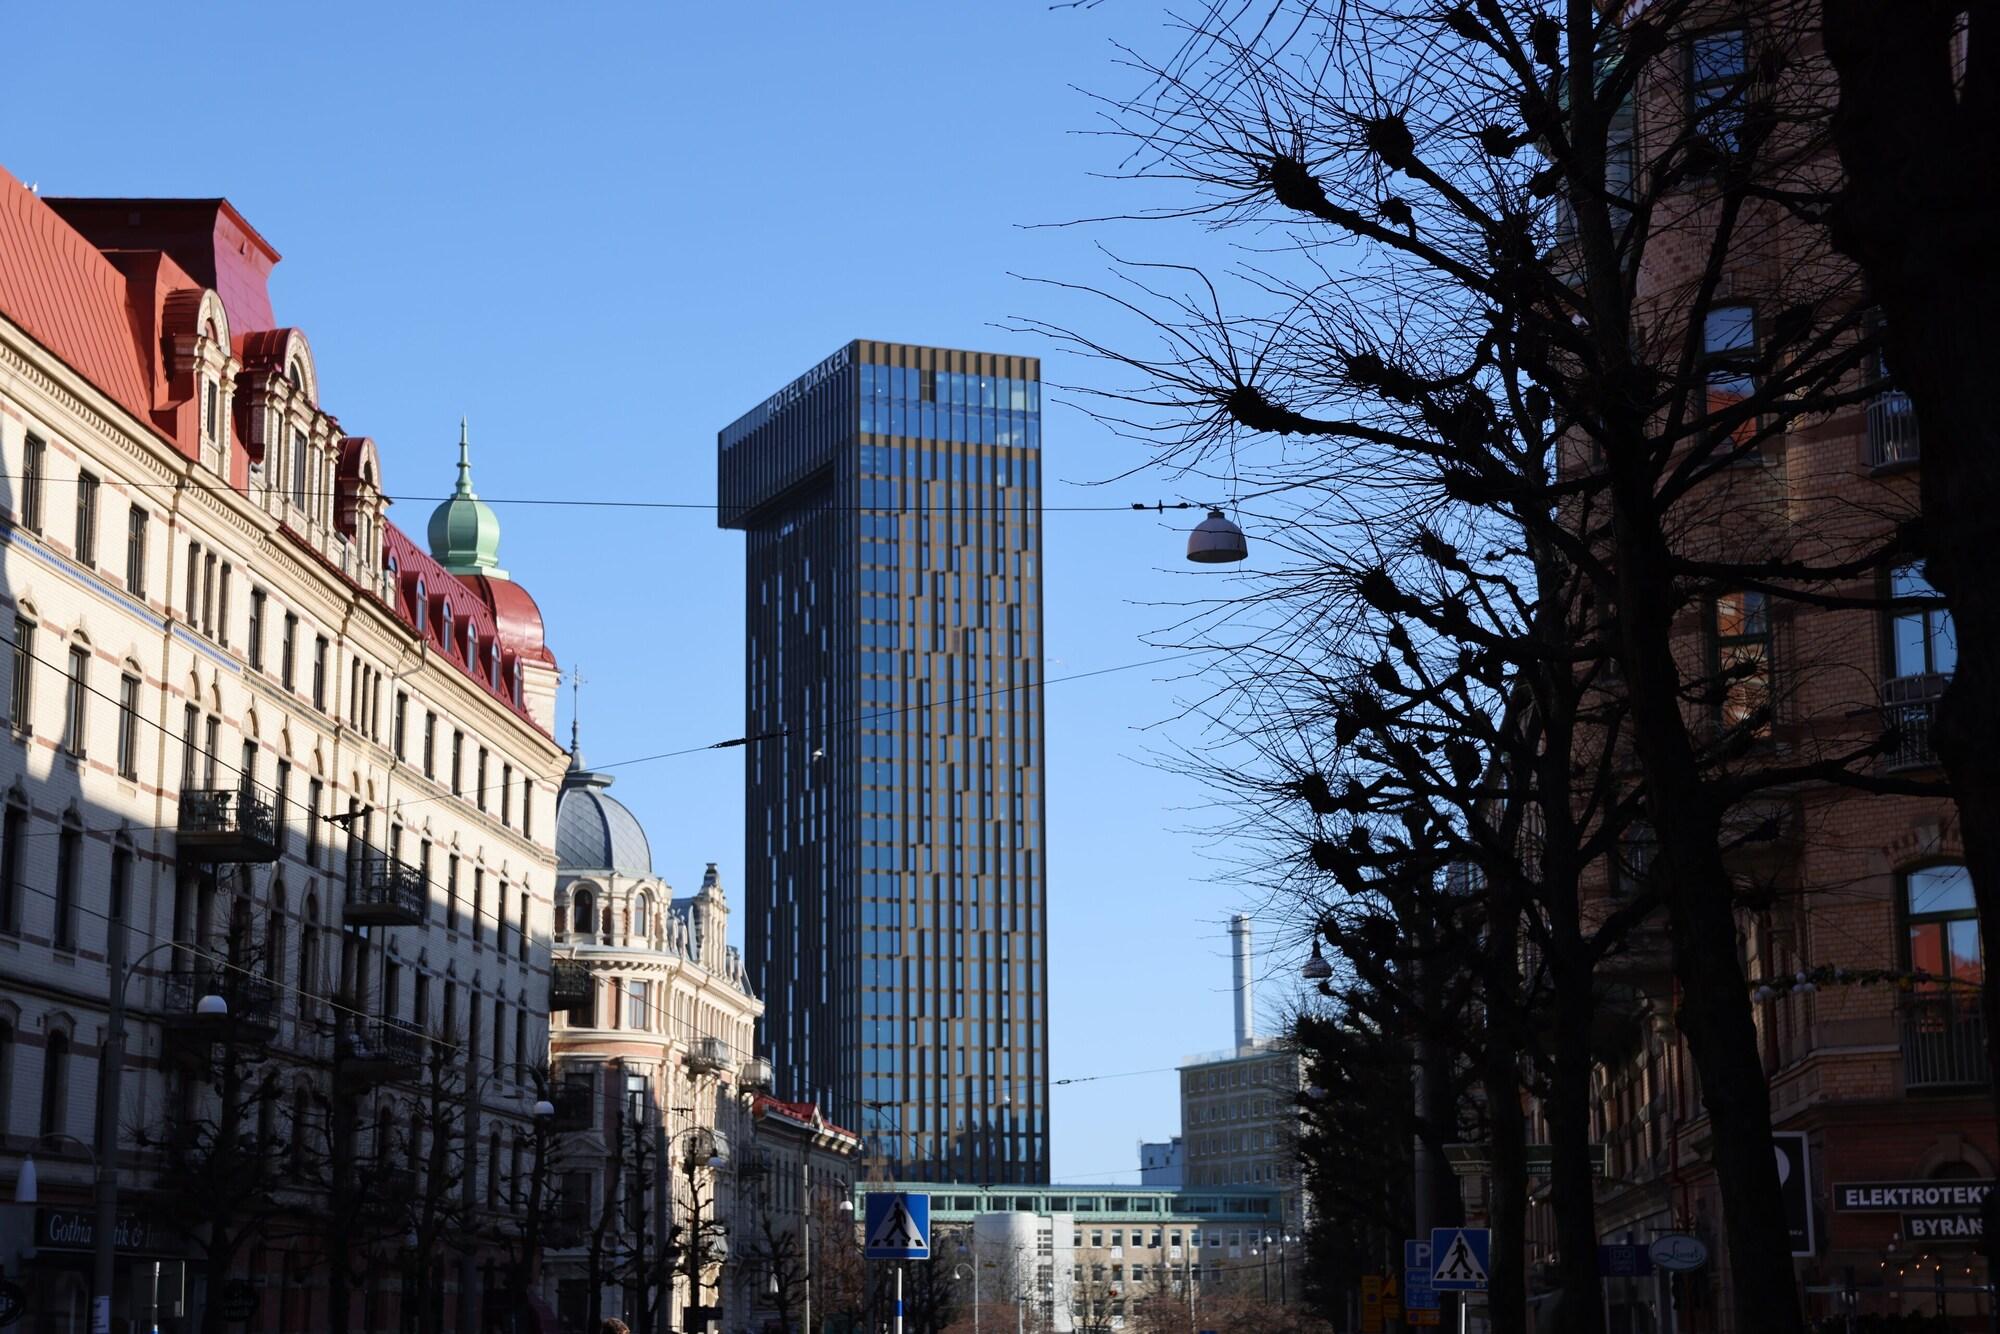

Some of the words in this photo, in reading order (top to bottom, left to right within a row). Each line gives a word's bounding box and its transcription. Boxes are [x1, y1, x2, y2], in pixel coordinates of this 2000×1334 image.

[767, 380, 801, 417] HOTEL
[805, 346, 848, 391] DRAKEN
[49, 1214, 92, 1246] Gothia
[1911, 1214, 1983, 1236] BYRÅN
[1415, 1243, 1431, 1266] P
